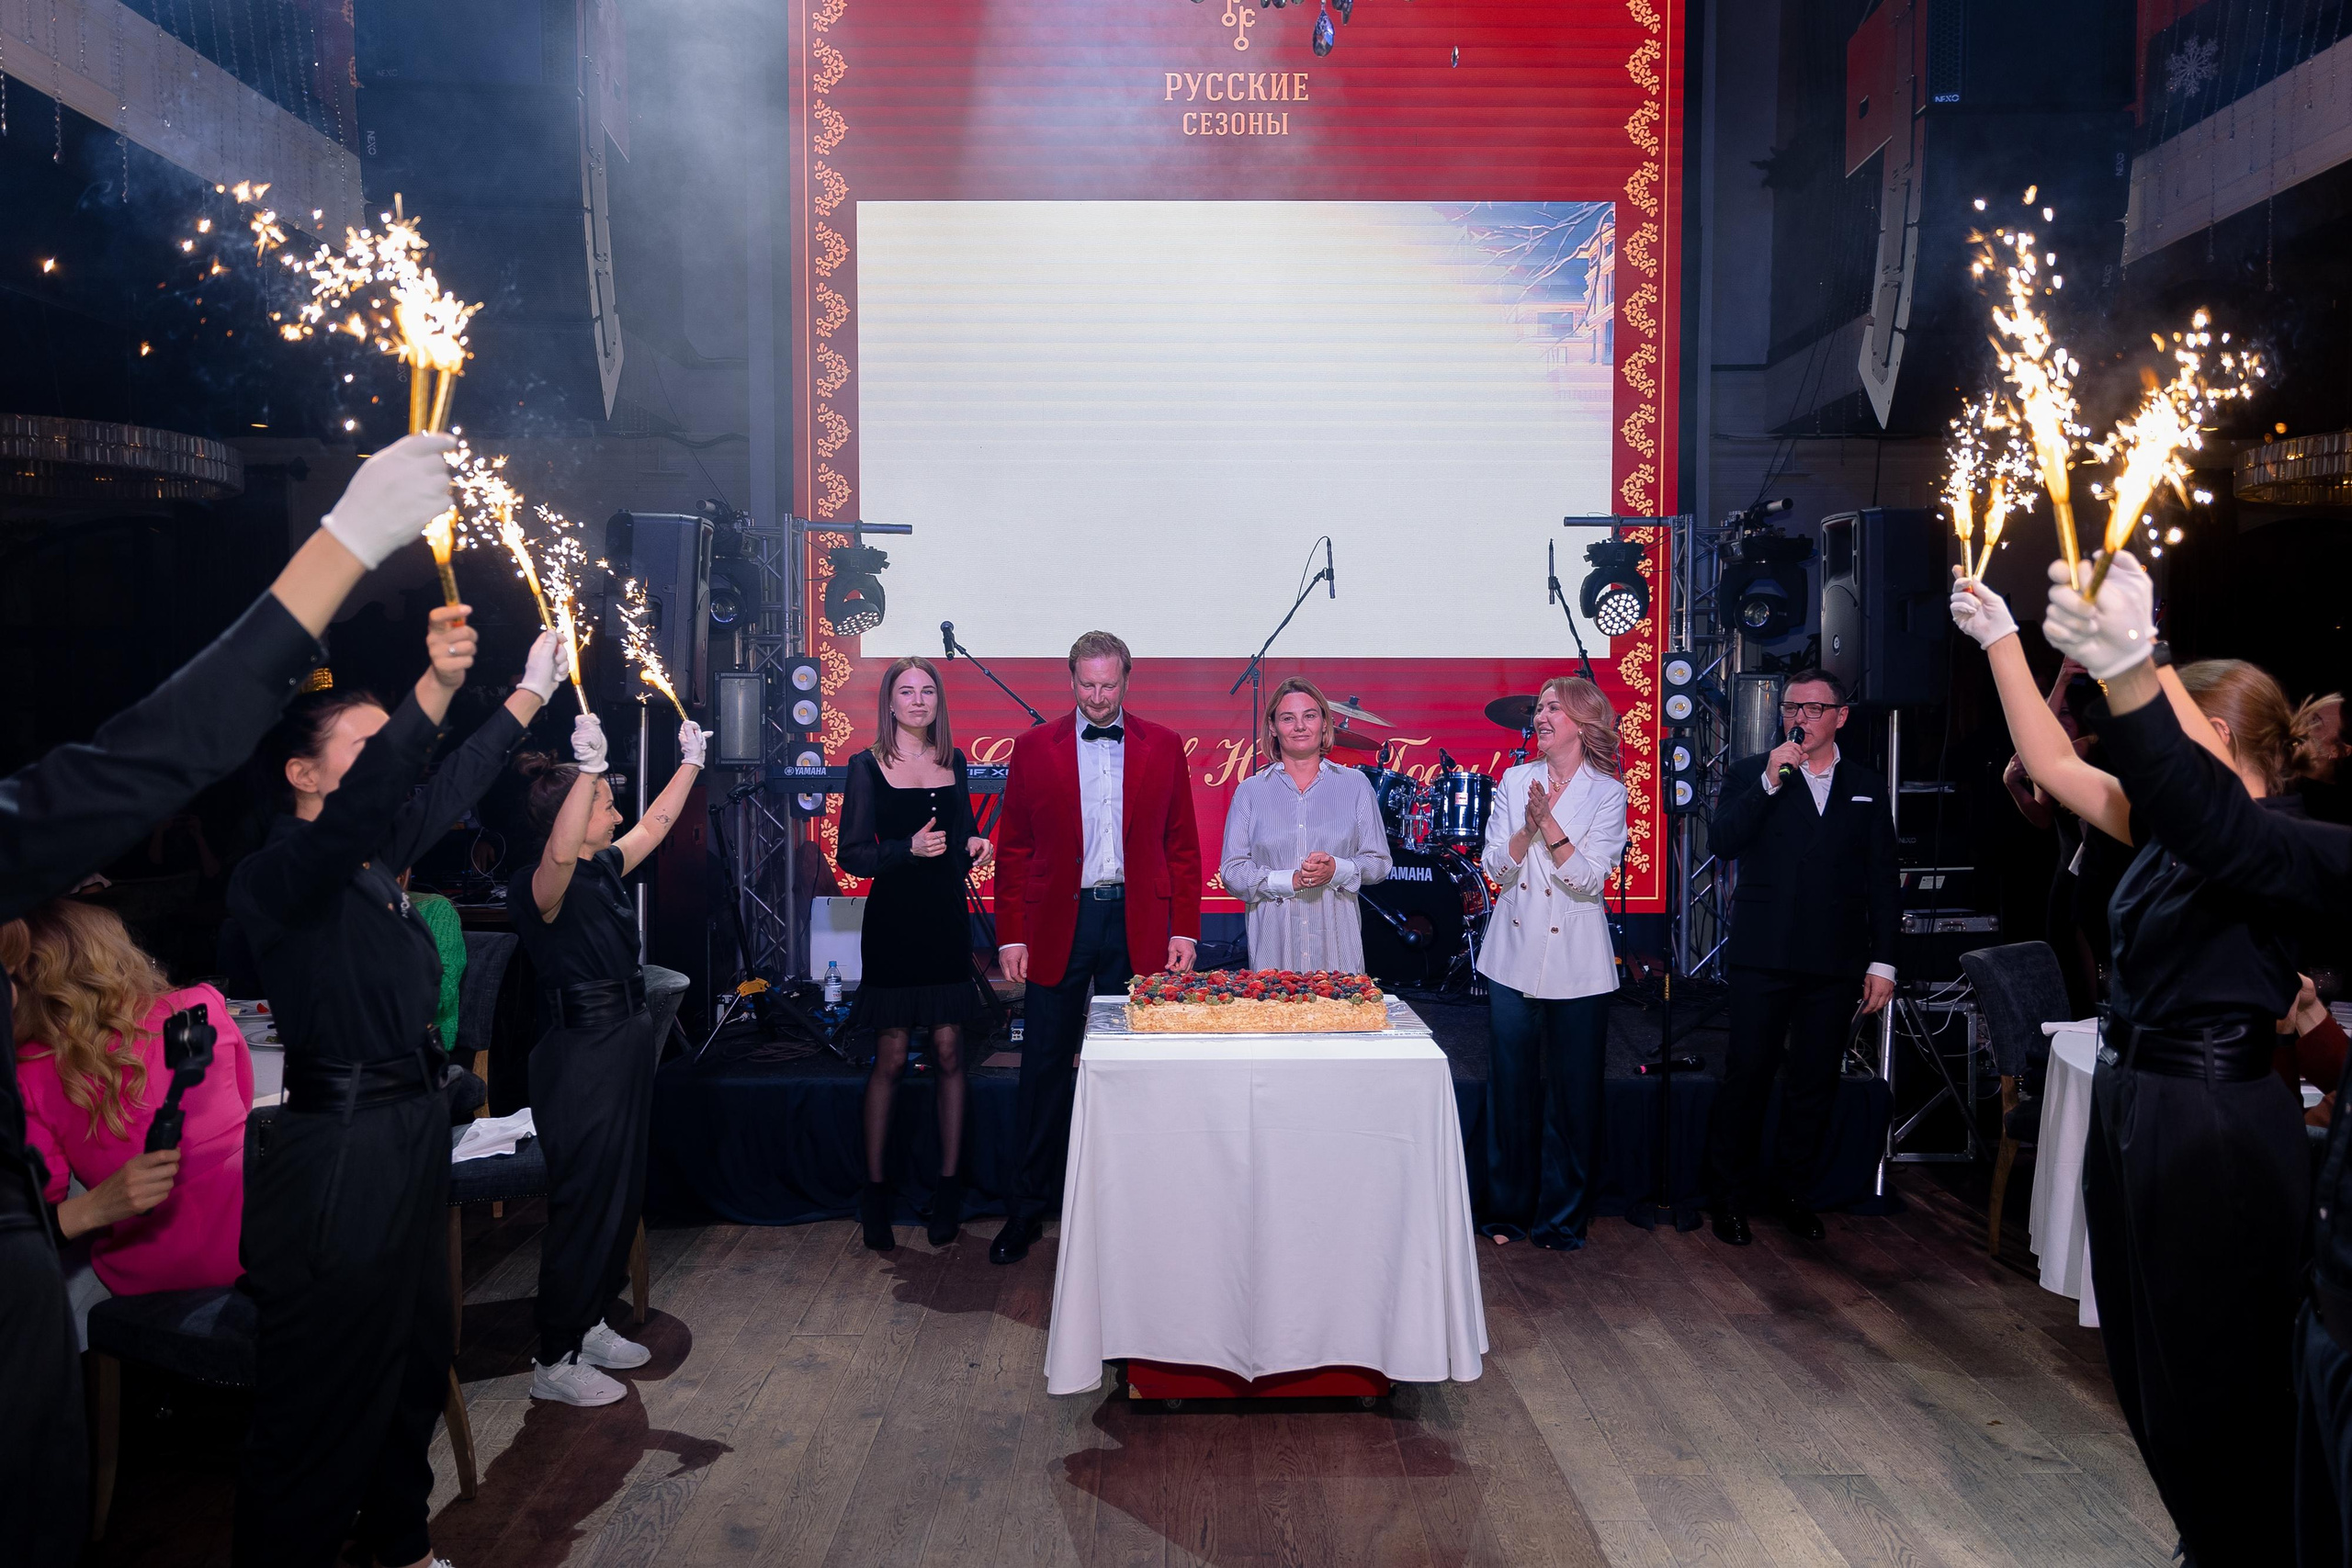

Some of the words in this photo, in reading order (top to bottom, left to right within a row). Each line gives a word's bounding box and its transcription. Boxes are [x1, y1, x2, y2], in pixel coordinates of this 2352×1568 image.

[1164, 73, 1309, 101] РУССКИЕ
[1934, 94, 1960, 103] NEXO
[1182, 112, 1289, 136] СЕЗОНЫ
[367, 130, 377, 156] NEXO
[2115, 152, 2125, 176] NEXO
[795, 766, 827, 775] YAMAHA
[1385, 866, 1433, 882] AMAHA
